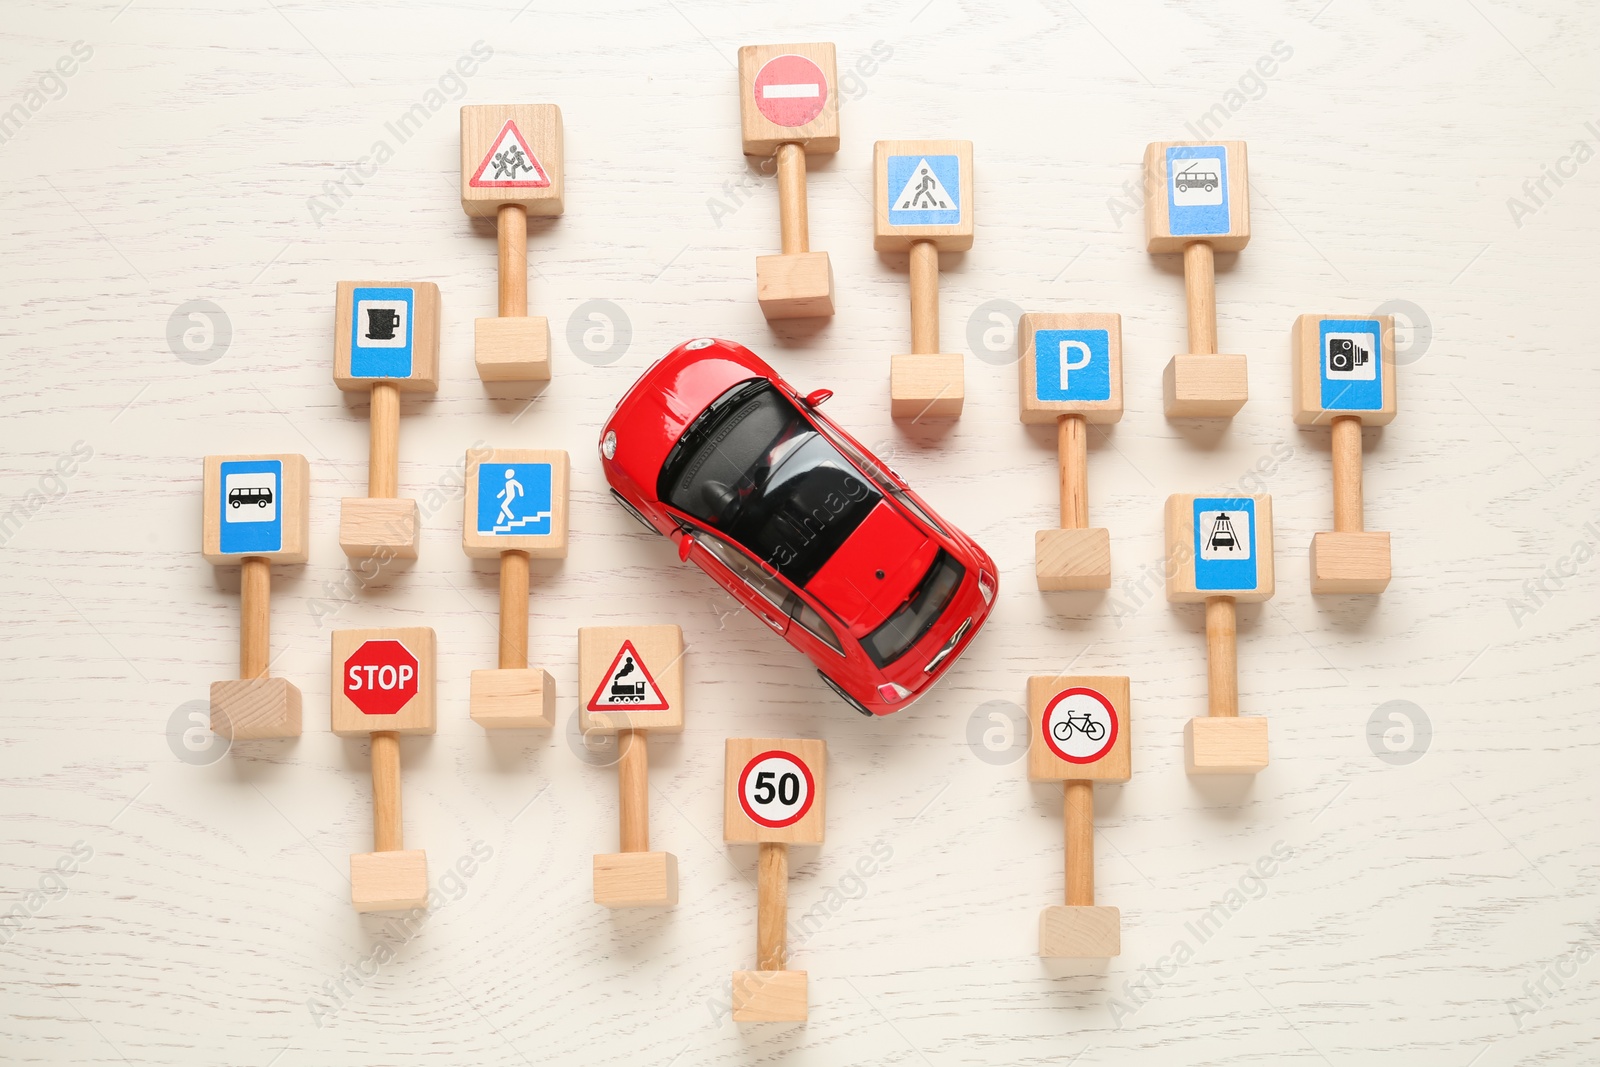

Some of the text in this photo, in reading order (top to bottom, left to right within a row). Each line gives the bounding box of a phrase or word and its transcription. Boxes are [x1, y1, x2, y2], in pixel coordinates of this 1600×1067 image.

[1059, 340, 1092, 390] P
[349, 665, 413, 690] STOP
[754, 772, 800, 805] 50
